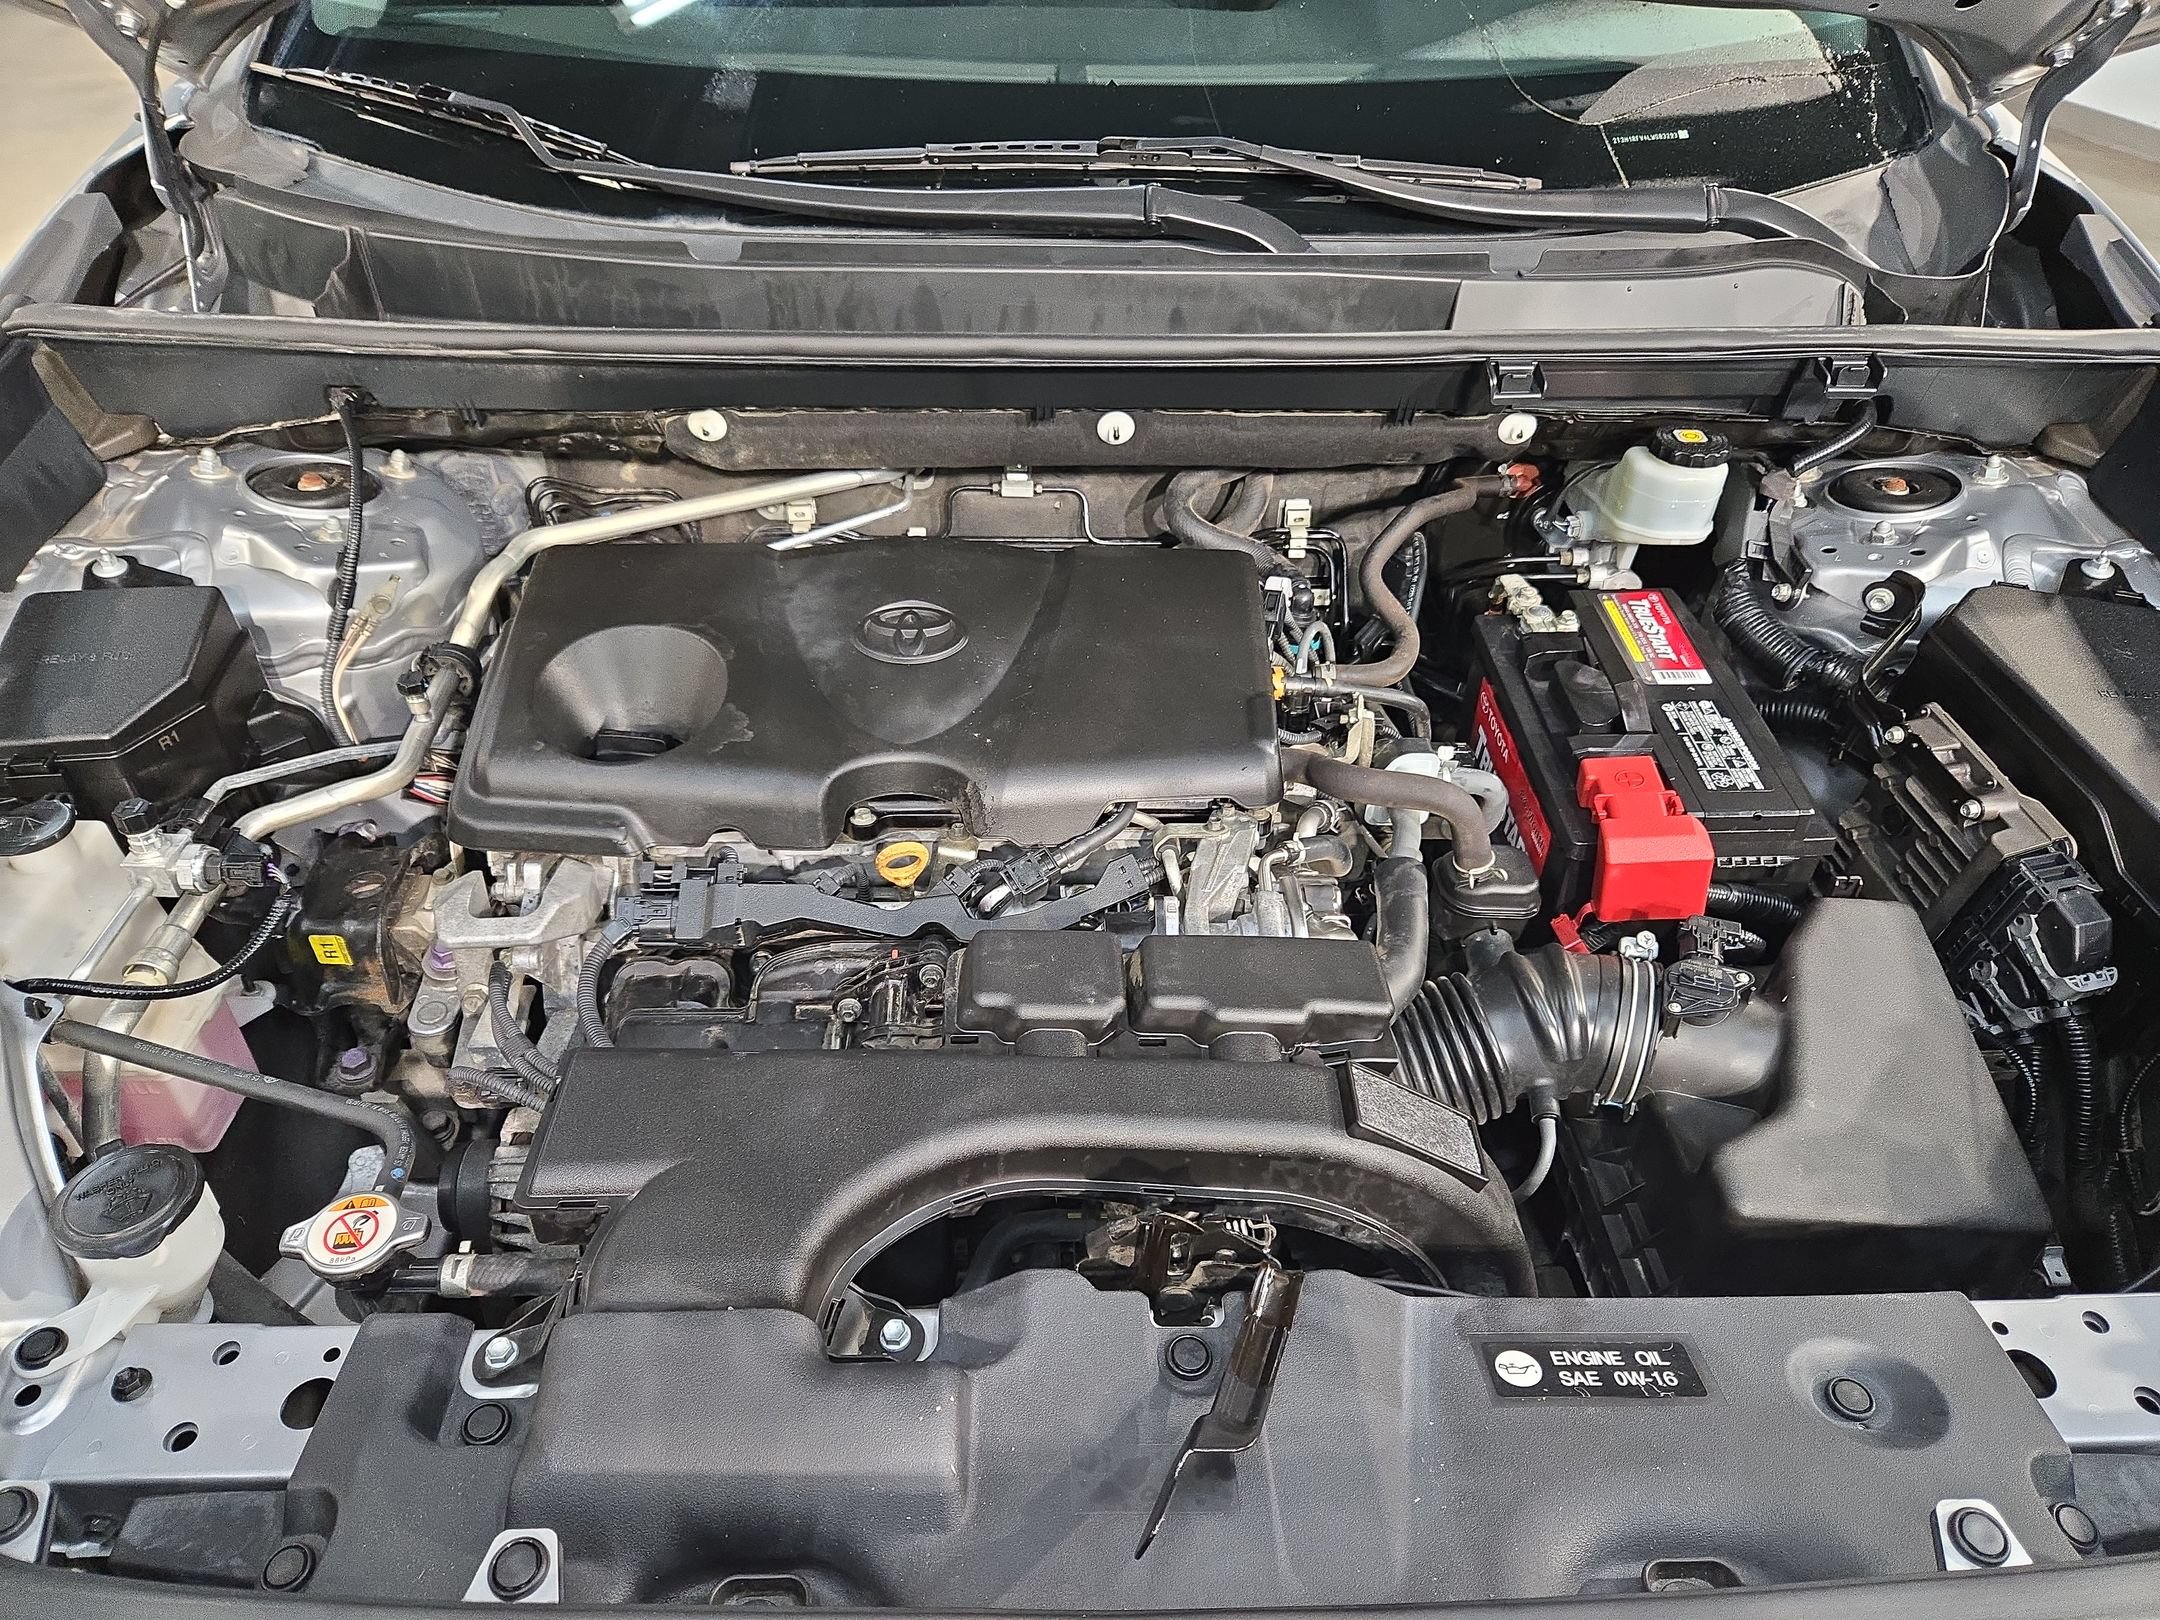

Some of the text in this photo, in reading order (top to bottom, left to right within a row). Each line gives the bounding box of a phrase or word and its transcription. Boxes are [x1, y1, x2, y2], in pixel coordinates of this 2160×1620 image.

[1652, 602, 1672, 625] TOYOTA
[157, 729, 181, 752] R1
[1487, 709, 1509, 764] TOYOTA
[319, 943, 340, 959] R1
[76, 1175, 124, 1201] WASHER
[105, 1178, 135, 1196] ONLY
[1549, 1350, 1672, 1367] ENGINE OIL
[1560, 1370, 1680, 1388] SAE 0W-16
